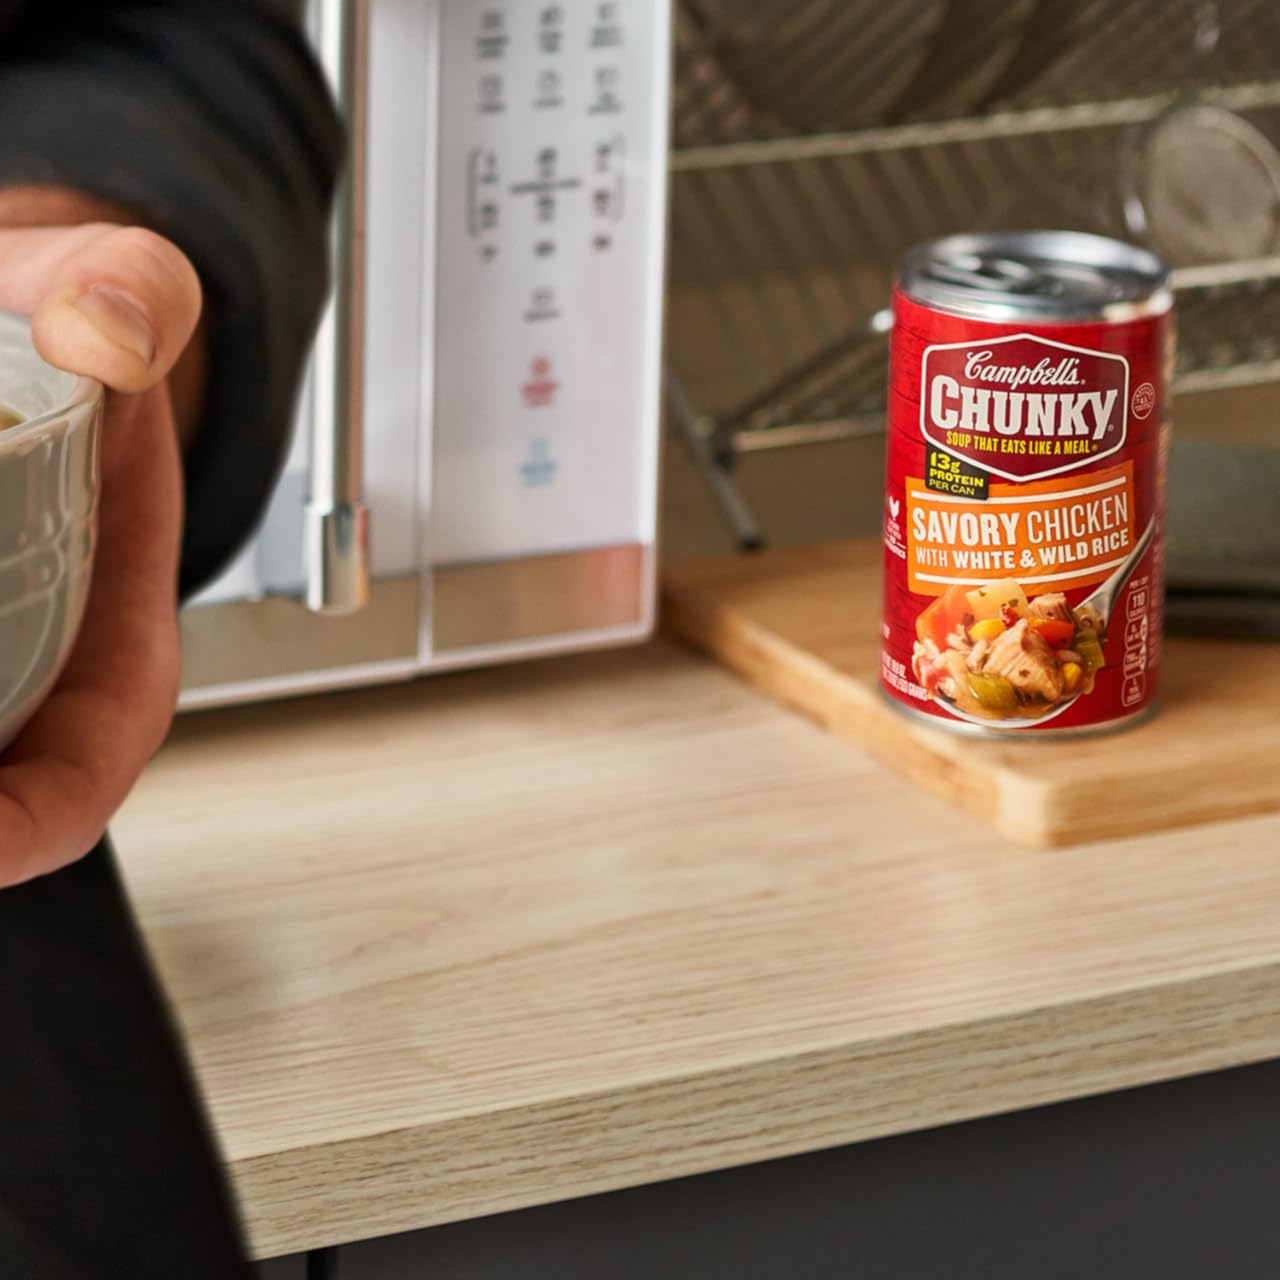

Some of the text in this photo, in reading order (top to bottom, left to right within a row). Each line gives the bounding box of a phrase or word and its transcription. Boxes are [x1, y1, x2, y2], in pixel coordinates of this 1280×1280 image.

[964, 350, 1080, 390] Campbell's
[930, 374, 1118, 440] CHUNKY
[946, 430, 1091, 455] SOUP THAT EATS LIKE A MEAL
[929, 468, 984, 487] PROTEIN
[930, 452, 961, 474] 13g
[929, 478, 975, 496] PER CAN
[912, 507, 1020, 547] SAVORY
[1027, 491, 1129, 544] CHICKEN
[915, 546, 948, 567] WITH
[952, 549, 1015, 569] WHITE
[1019, 549, 1036, 568] &
[1038, 541, 1089, 566] WILD
[1091, 528, 1130, 556] RICE
